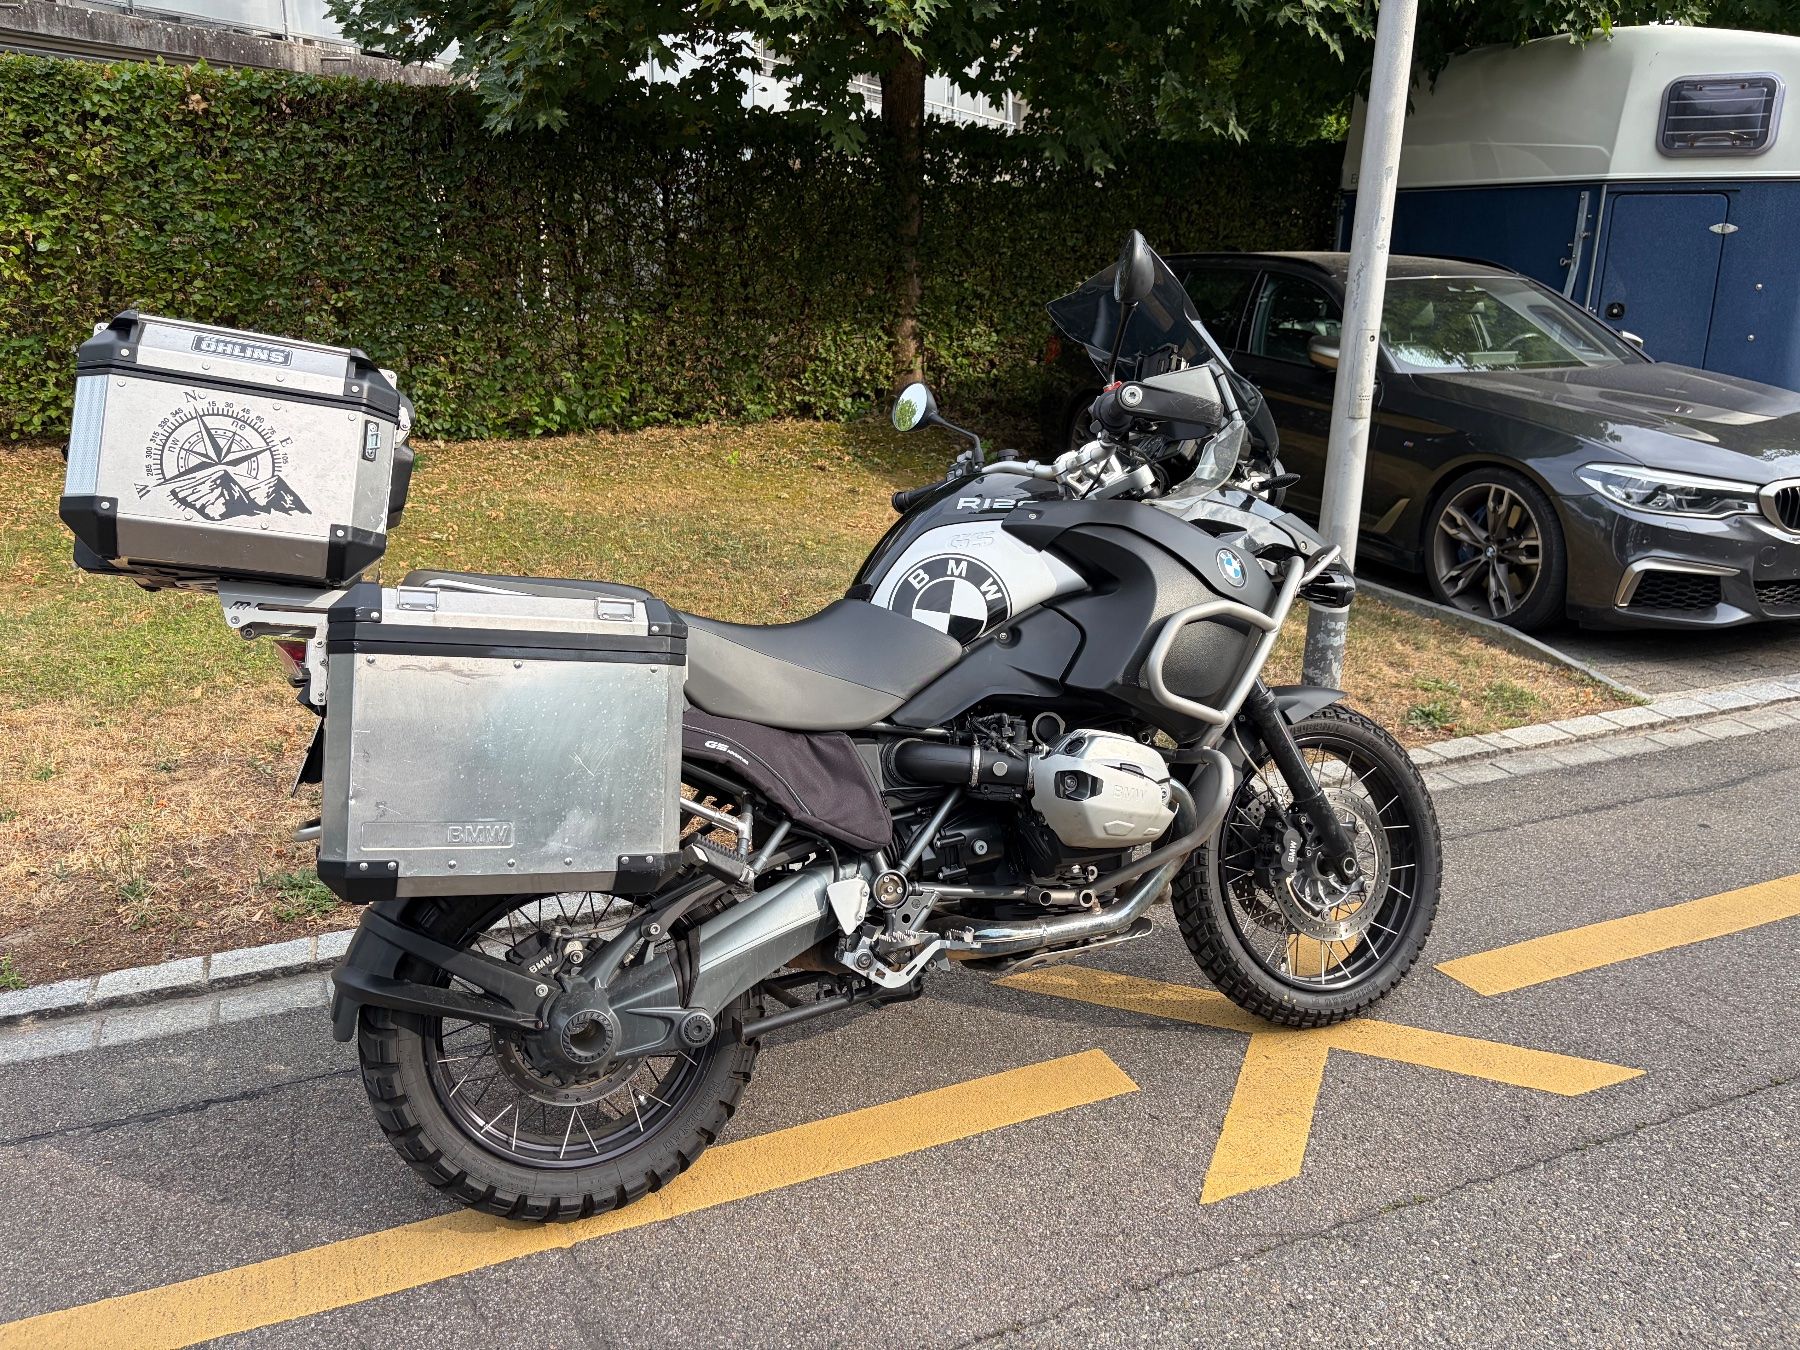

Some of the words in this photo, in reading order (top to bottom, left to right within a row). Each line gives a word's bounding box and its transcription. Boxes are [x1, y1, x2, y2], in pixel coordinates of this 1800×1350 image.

[183, 390, 198, 403] N
[231, 420, 246, 431] ne
[279, 436, 294, 448] E
[145, 446, 153, 459] 300
[133, 483, 152, 500] W
[956, 497, 1039, 510] R12
[907, 559, 1003, 601] BMW
[447, 825, 508, 844] BMW
[1287, 840, 1297, 863] BMW
[529, 954, 553, 973] BMW
